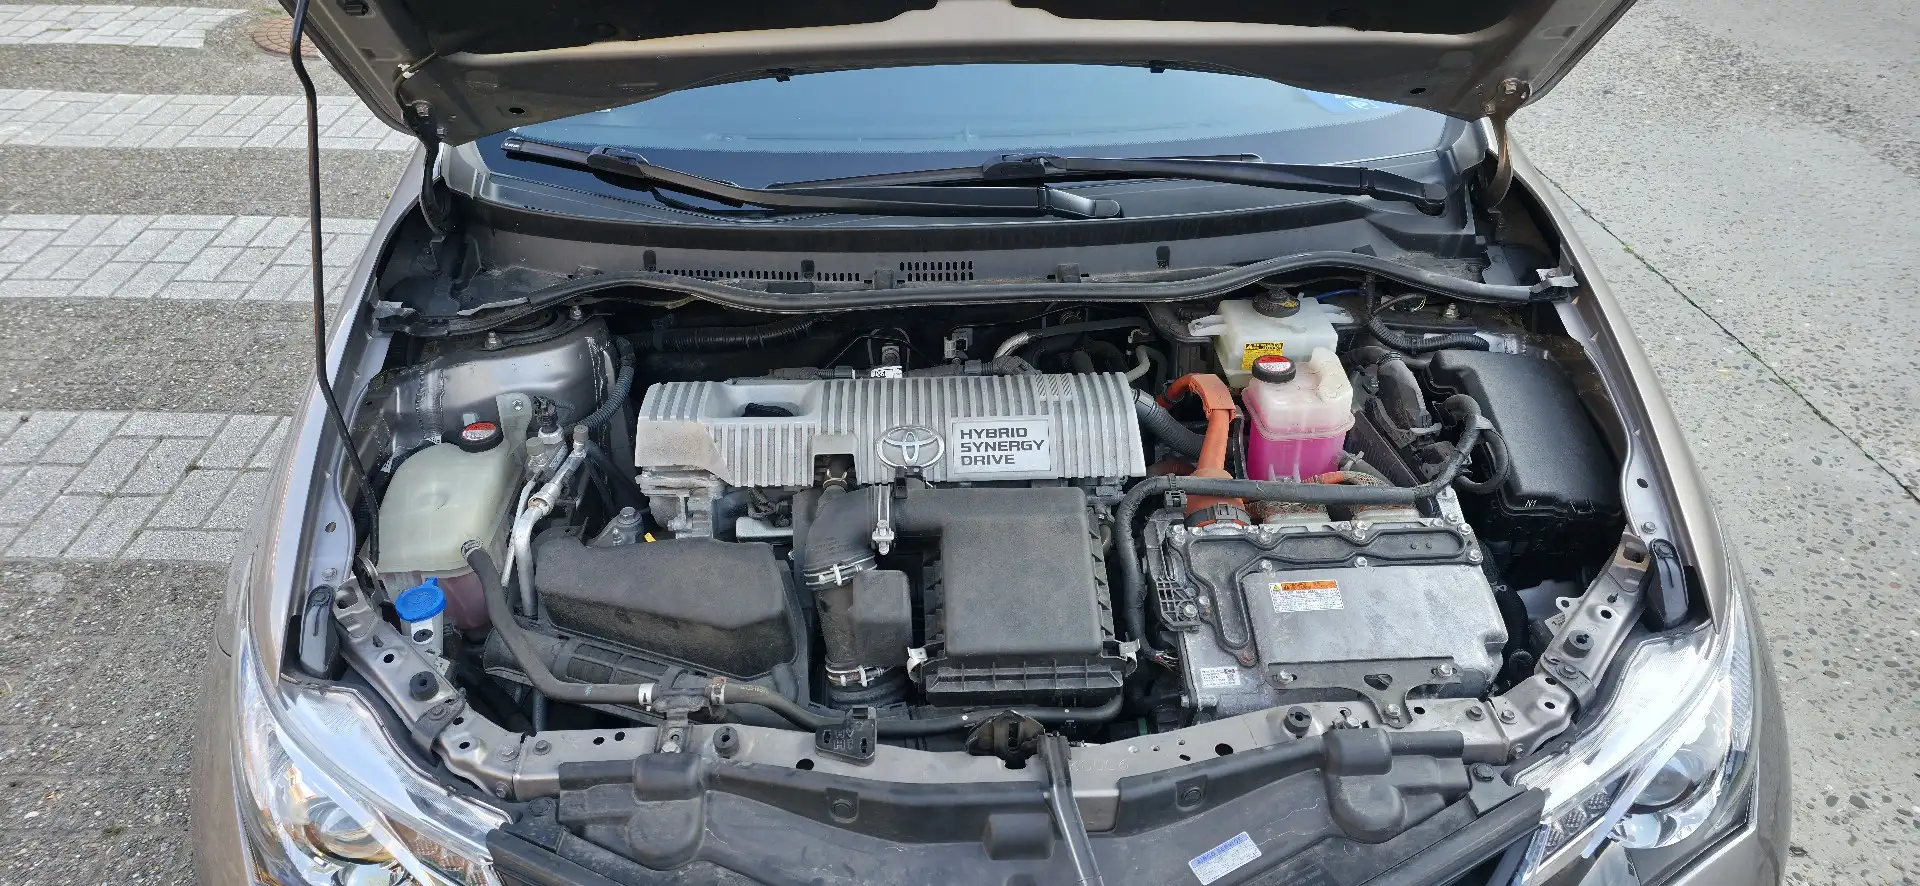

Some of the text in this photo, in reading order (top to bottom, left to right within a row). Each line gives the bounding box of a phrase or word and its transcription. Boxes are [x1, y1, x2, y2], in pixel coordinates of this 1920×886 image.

[960, 428, 1027, 439] HYBRID
[960, 440, 1045, 452] SYNERGY
[961, 454, 1015, 465] DRIVE
[836, 729, 854, 738] HV
